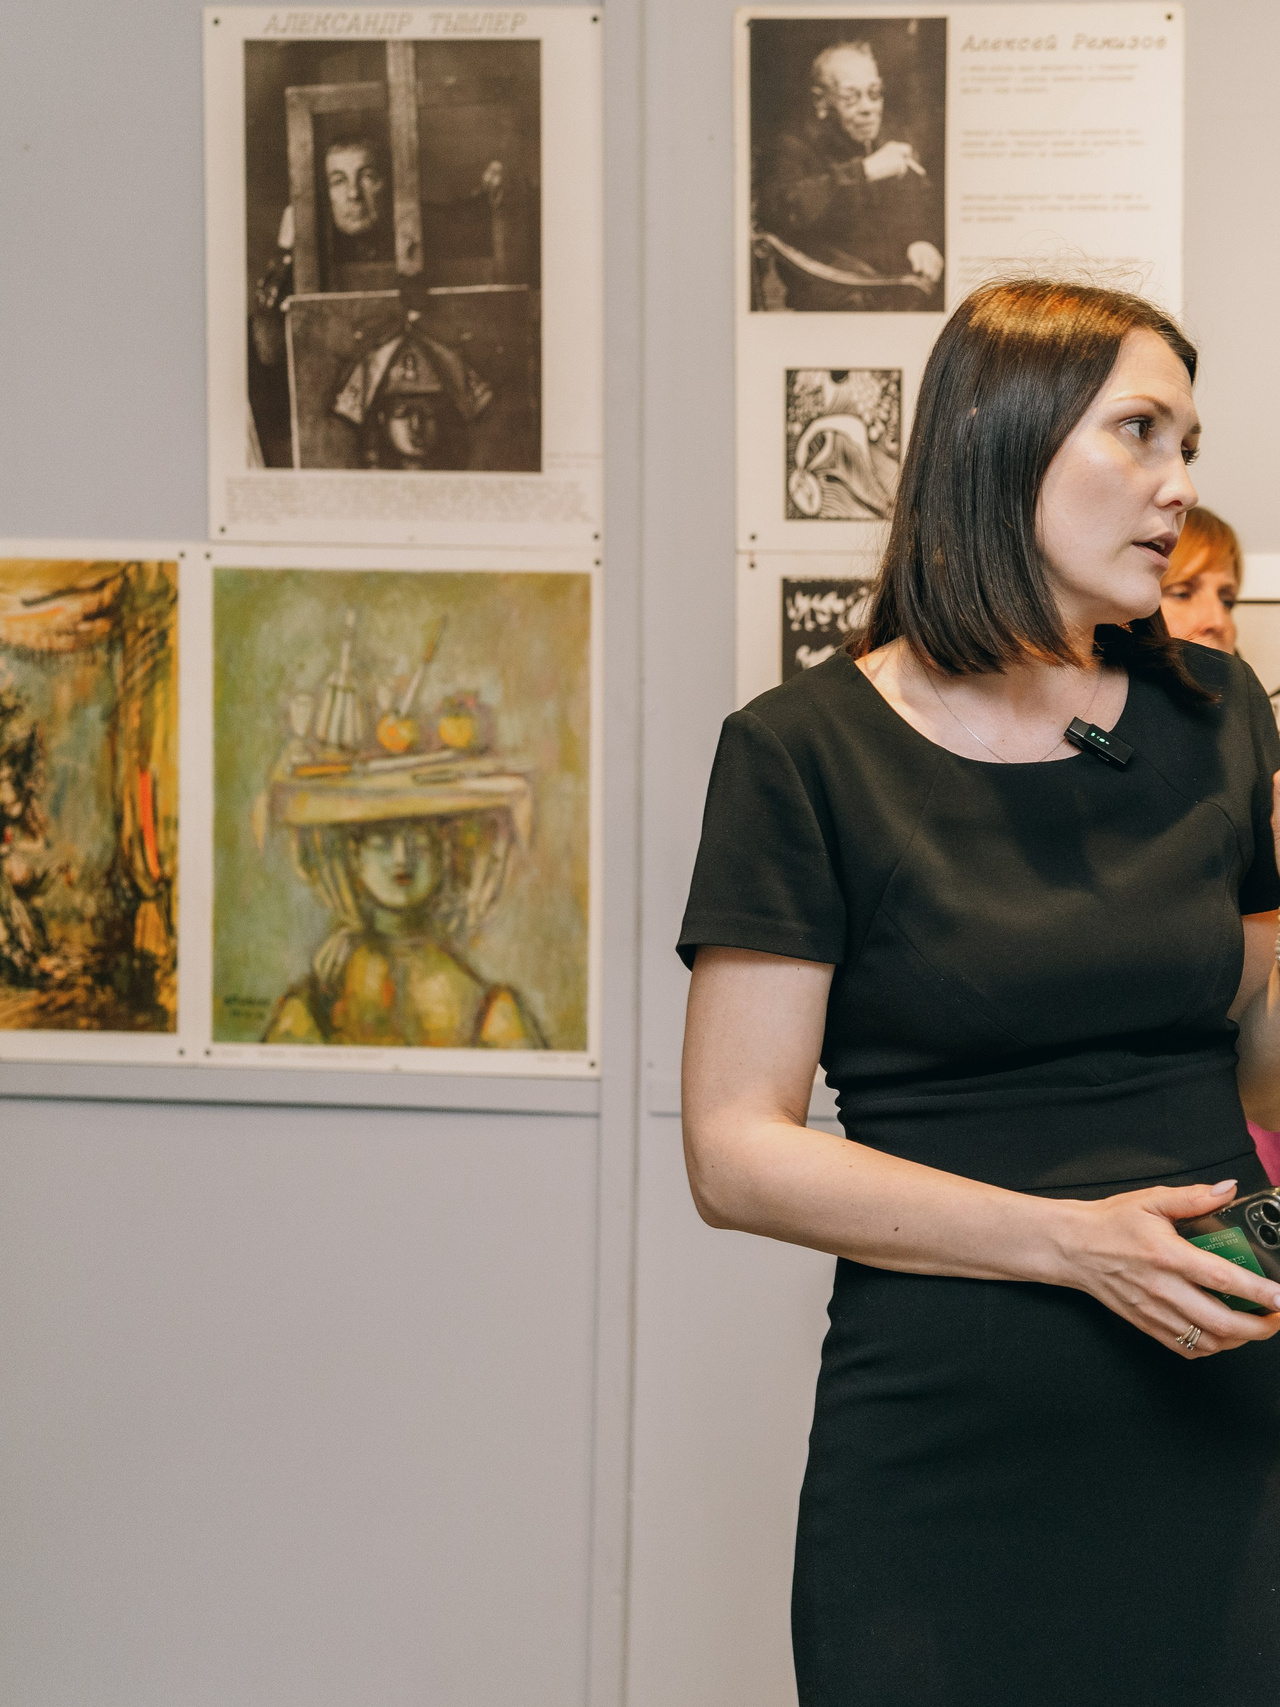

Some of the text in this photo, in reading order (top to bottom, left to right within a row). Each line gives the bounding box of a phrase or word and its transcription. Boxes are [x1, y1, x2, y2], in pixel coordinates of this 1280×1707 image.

[263, 12, 528, 35] АЛЕКСАНДР ТЫШЛЕР
[961, 33, 1058, 51] Алексей
